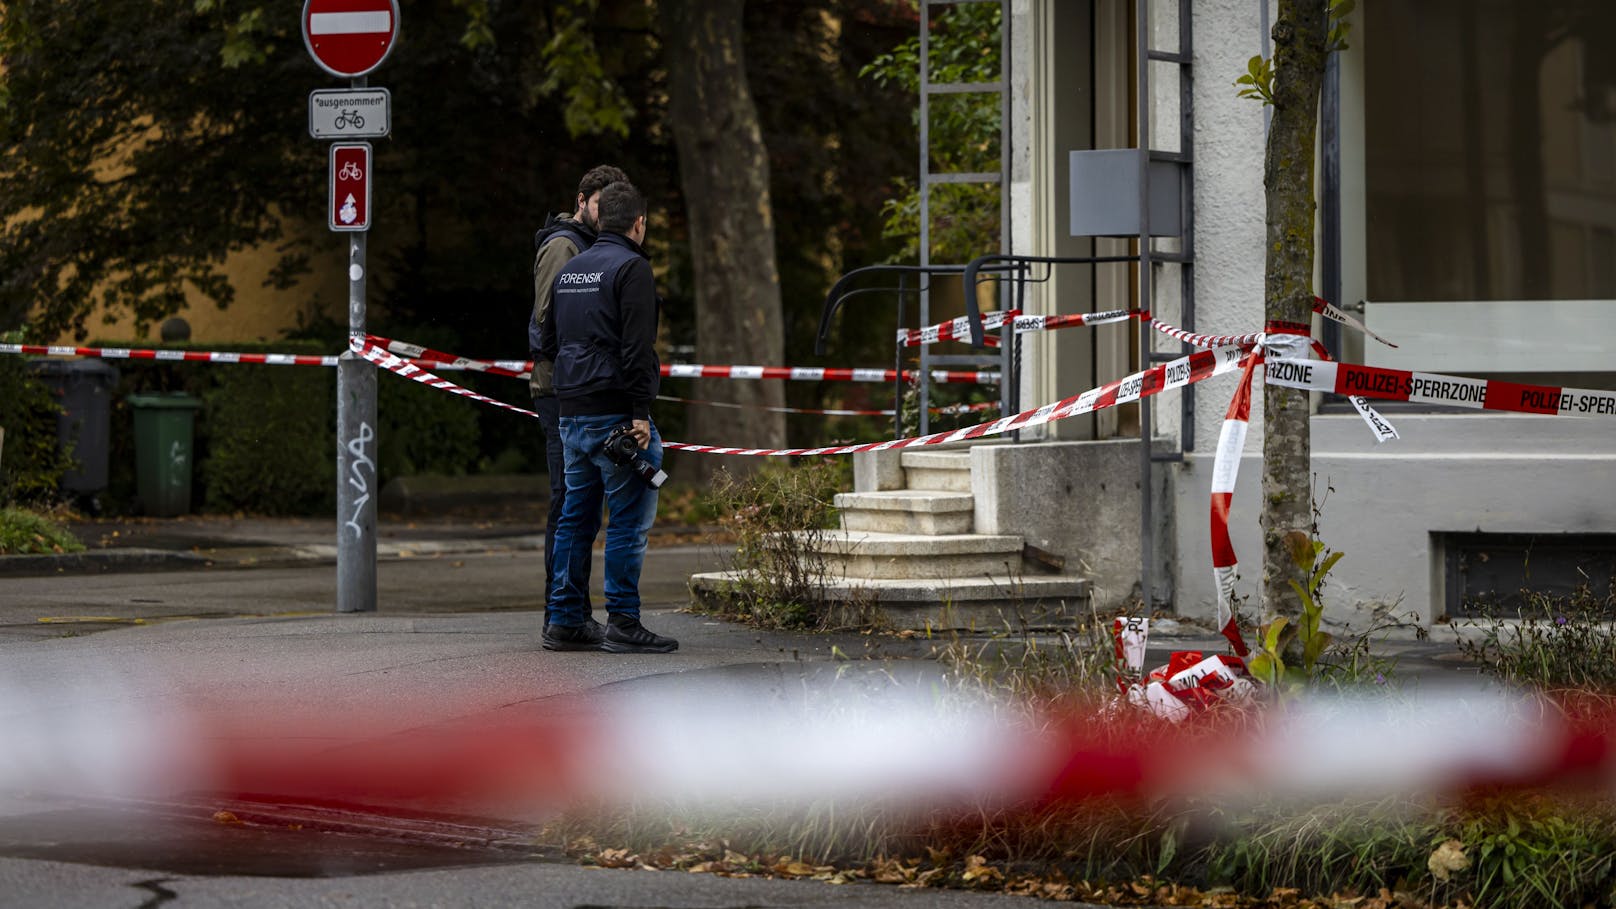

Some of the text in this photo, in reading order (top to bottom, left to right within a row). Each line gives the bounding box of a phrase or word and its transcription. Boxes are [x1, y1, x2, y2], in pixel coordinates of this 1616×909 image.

[319, 97, 381, 109] ausgenommen
[559, 271, 604, 285] FORENSIK
[1345, 370, 1487, 403] POLIZEI-SPERRZONE
[1519, 390, 1616, 415] POLIZEI-SPER
